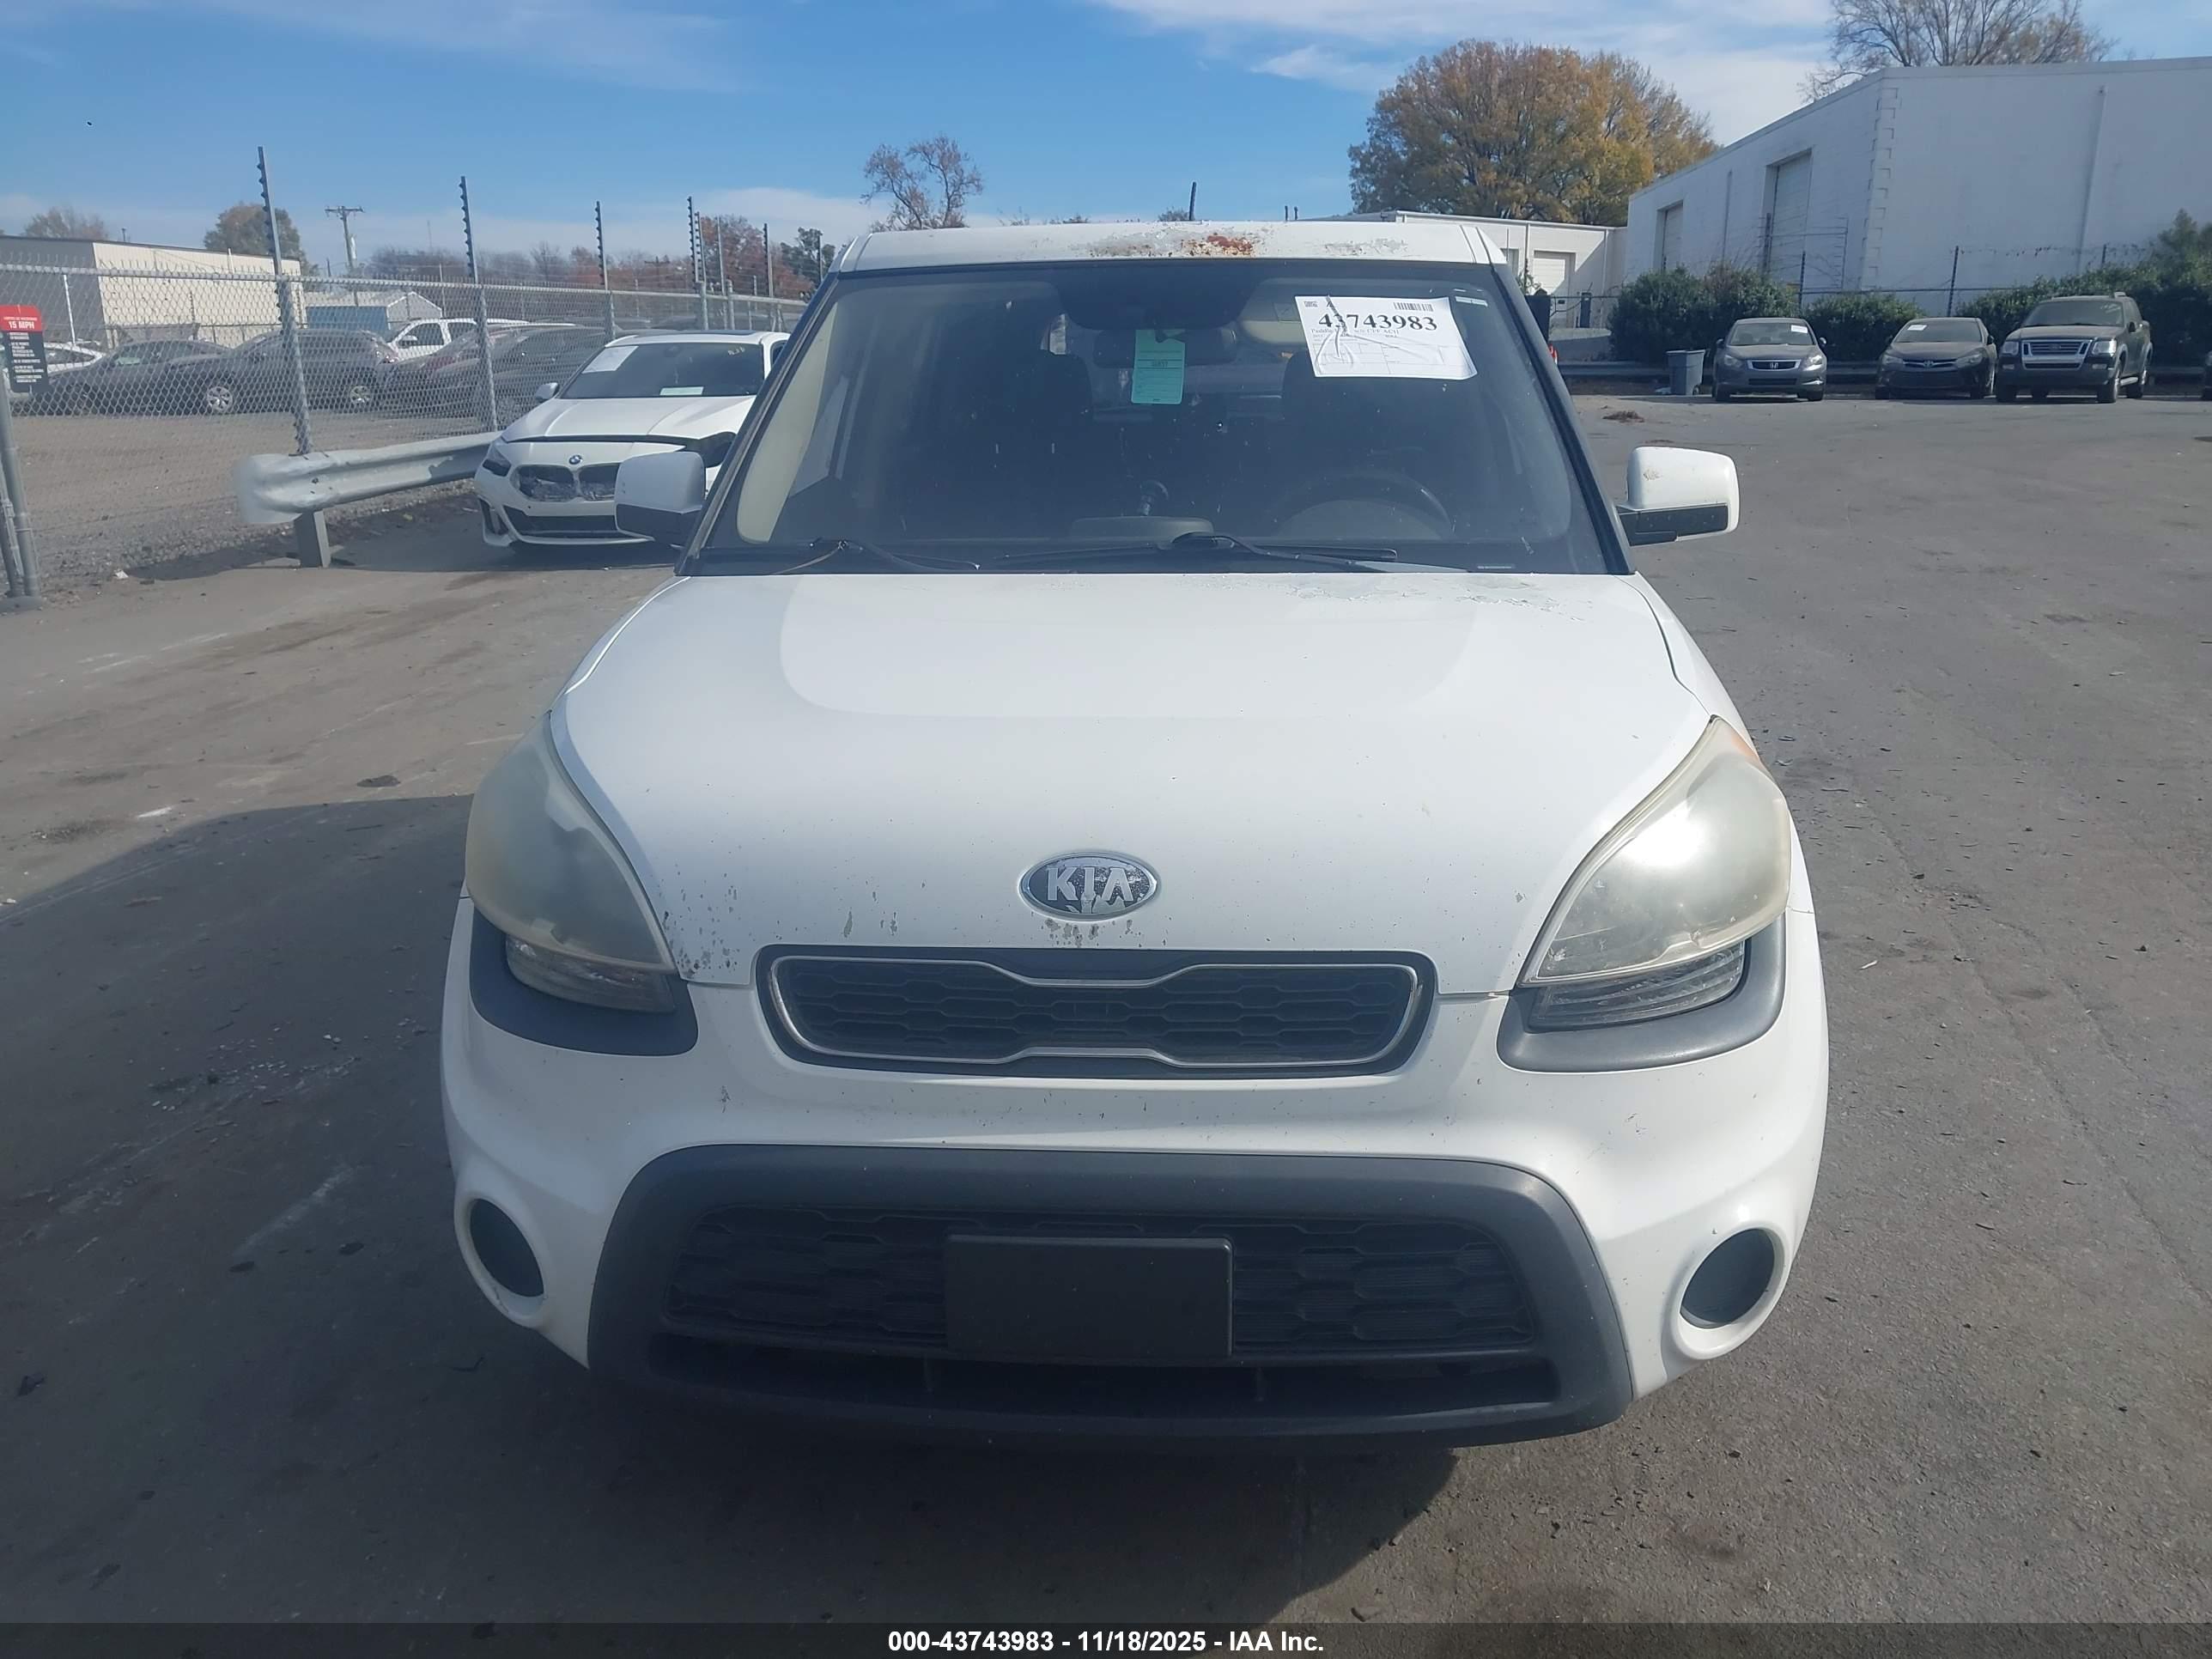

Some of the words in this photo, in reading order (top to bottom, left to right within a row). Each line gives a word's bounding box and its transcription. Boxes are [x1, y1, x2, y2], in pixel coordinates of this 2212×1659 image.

[8, 320, 17, 329] 15
[18, 320, 35, 330] MPH
[1047, 866, 1134, 902] KIA
